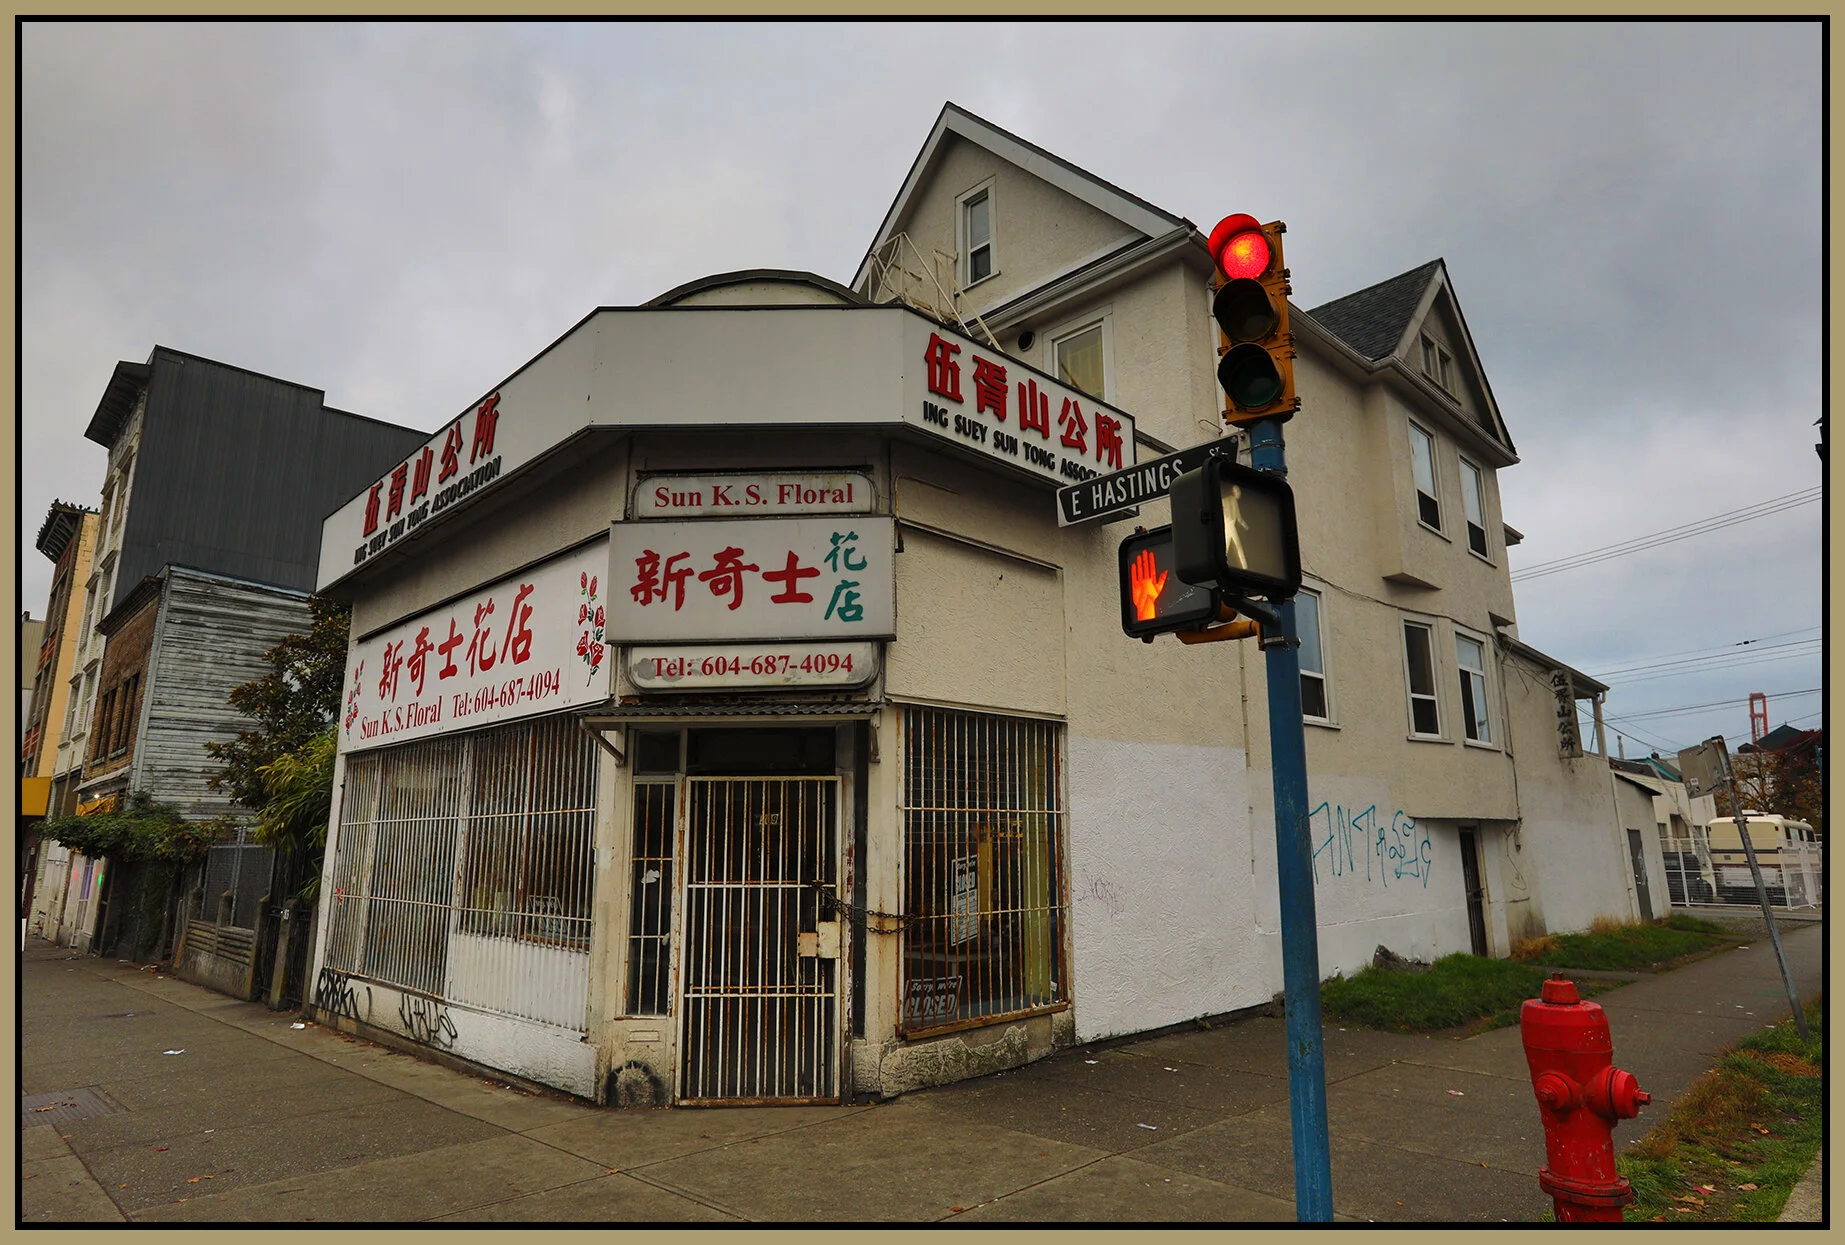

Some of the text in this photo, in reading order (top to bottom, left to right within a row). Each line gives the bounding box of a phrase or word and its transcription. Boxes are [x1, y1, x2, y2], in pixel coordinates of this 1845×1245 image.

[923, 400, 1102, 481] ING SUEY SUN TONG ASSOC
[924, 332, 1123, 470] 伍胥山公所
[363, 392, 501, 537] 伍胥山公所
[654, 486, 702, 508] Sun
[777, 483, 853, 504] Floral
[1072, 491, 1082, 516] E
[1092, 458, 1184, 510] HASTINGS
[354, 455, 502, 565] ING SUEY SUN TONG ASSOCIATION
[379, 584, 534, 703] 新奇士花店
[651, 653, 854, 676] Tel: 604-687-4094
[360, 716, 378, 740] Sun
[405, 696, 442, 729] Floral
[452, 692, 472, 719] Tel:
[474, 668, 560, 714] 604-687-4094
